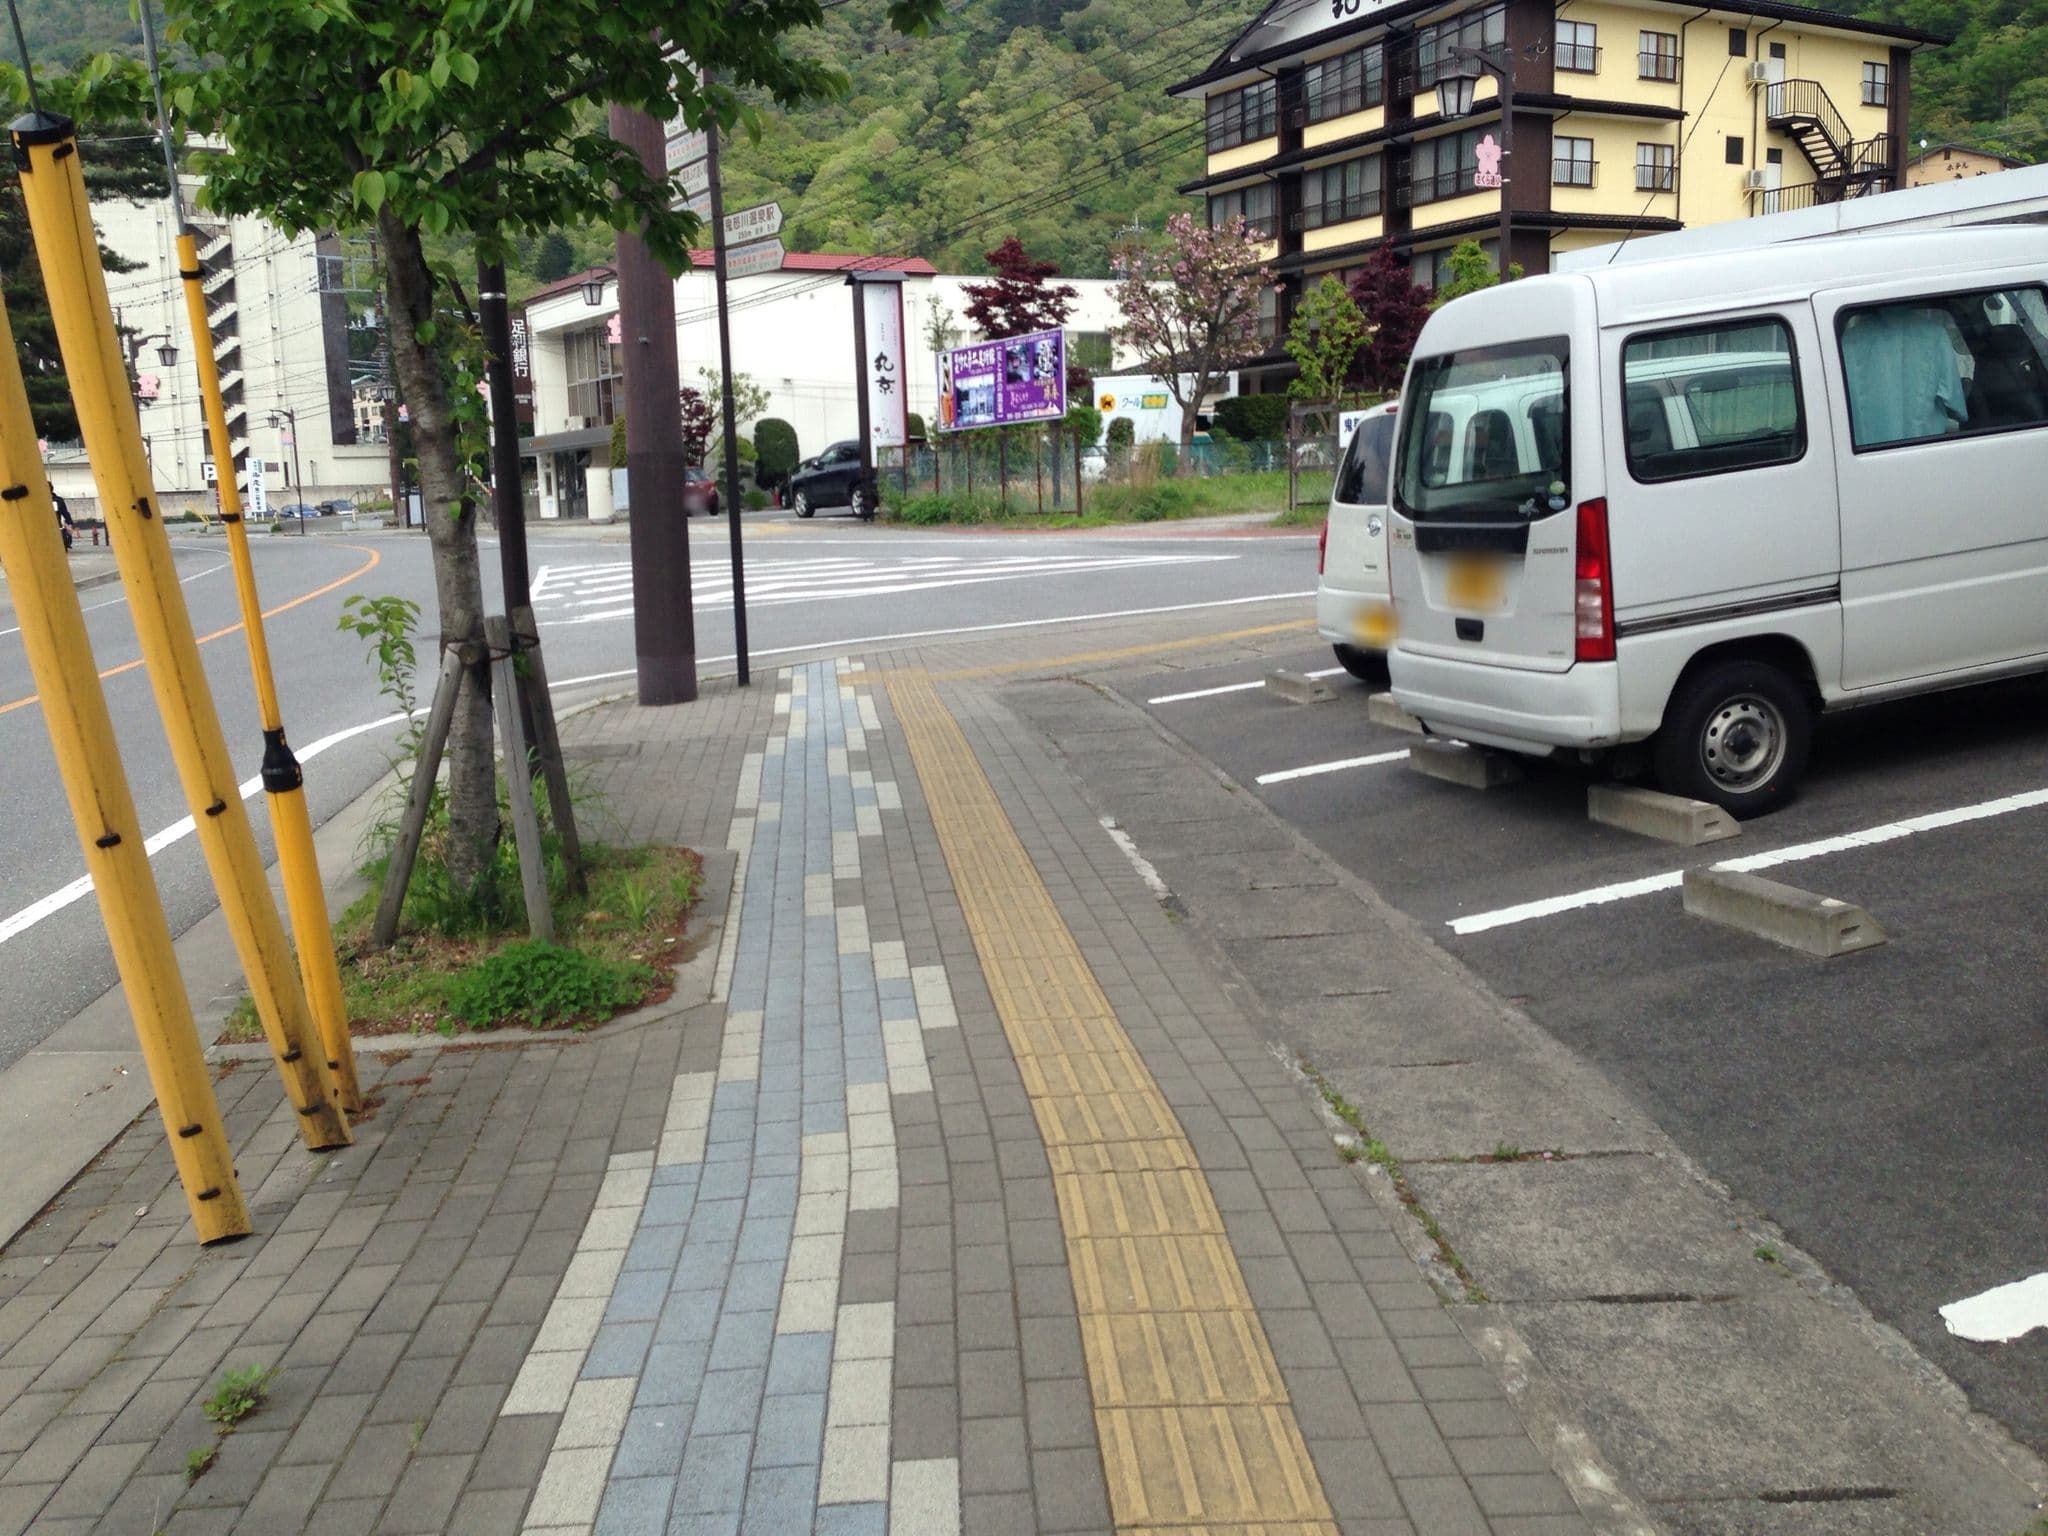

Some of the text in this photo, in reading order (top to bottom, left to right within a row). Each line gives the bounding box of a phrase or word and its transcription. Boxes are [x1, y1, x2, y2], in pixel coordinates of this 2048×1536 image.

[725, 206, 775, 232] 鬼怒川温泉駅
[512, 319, 529, 377] 足利銀行
